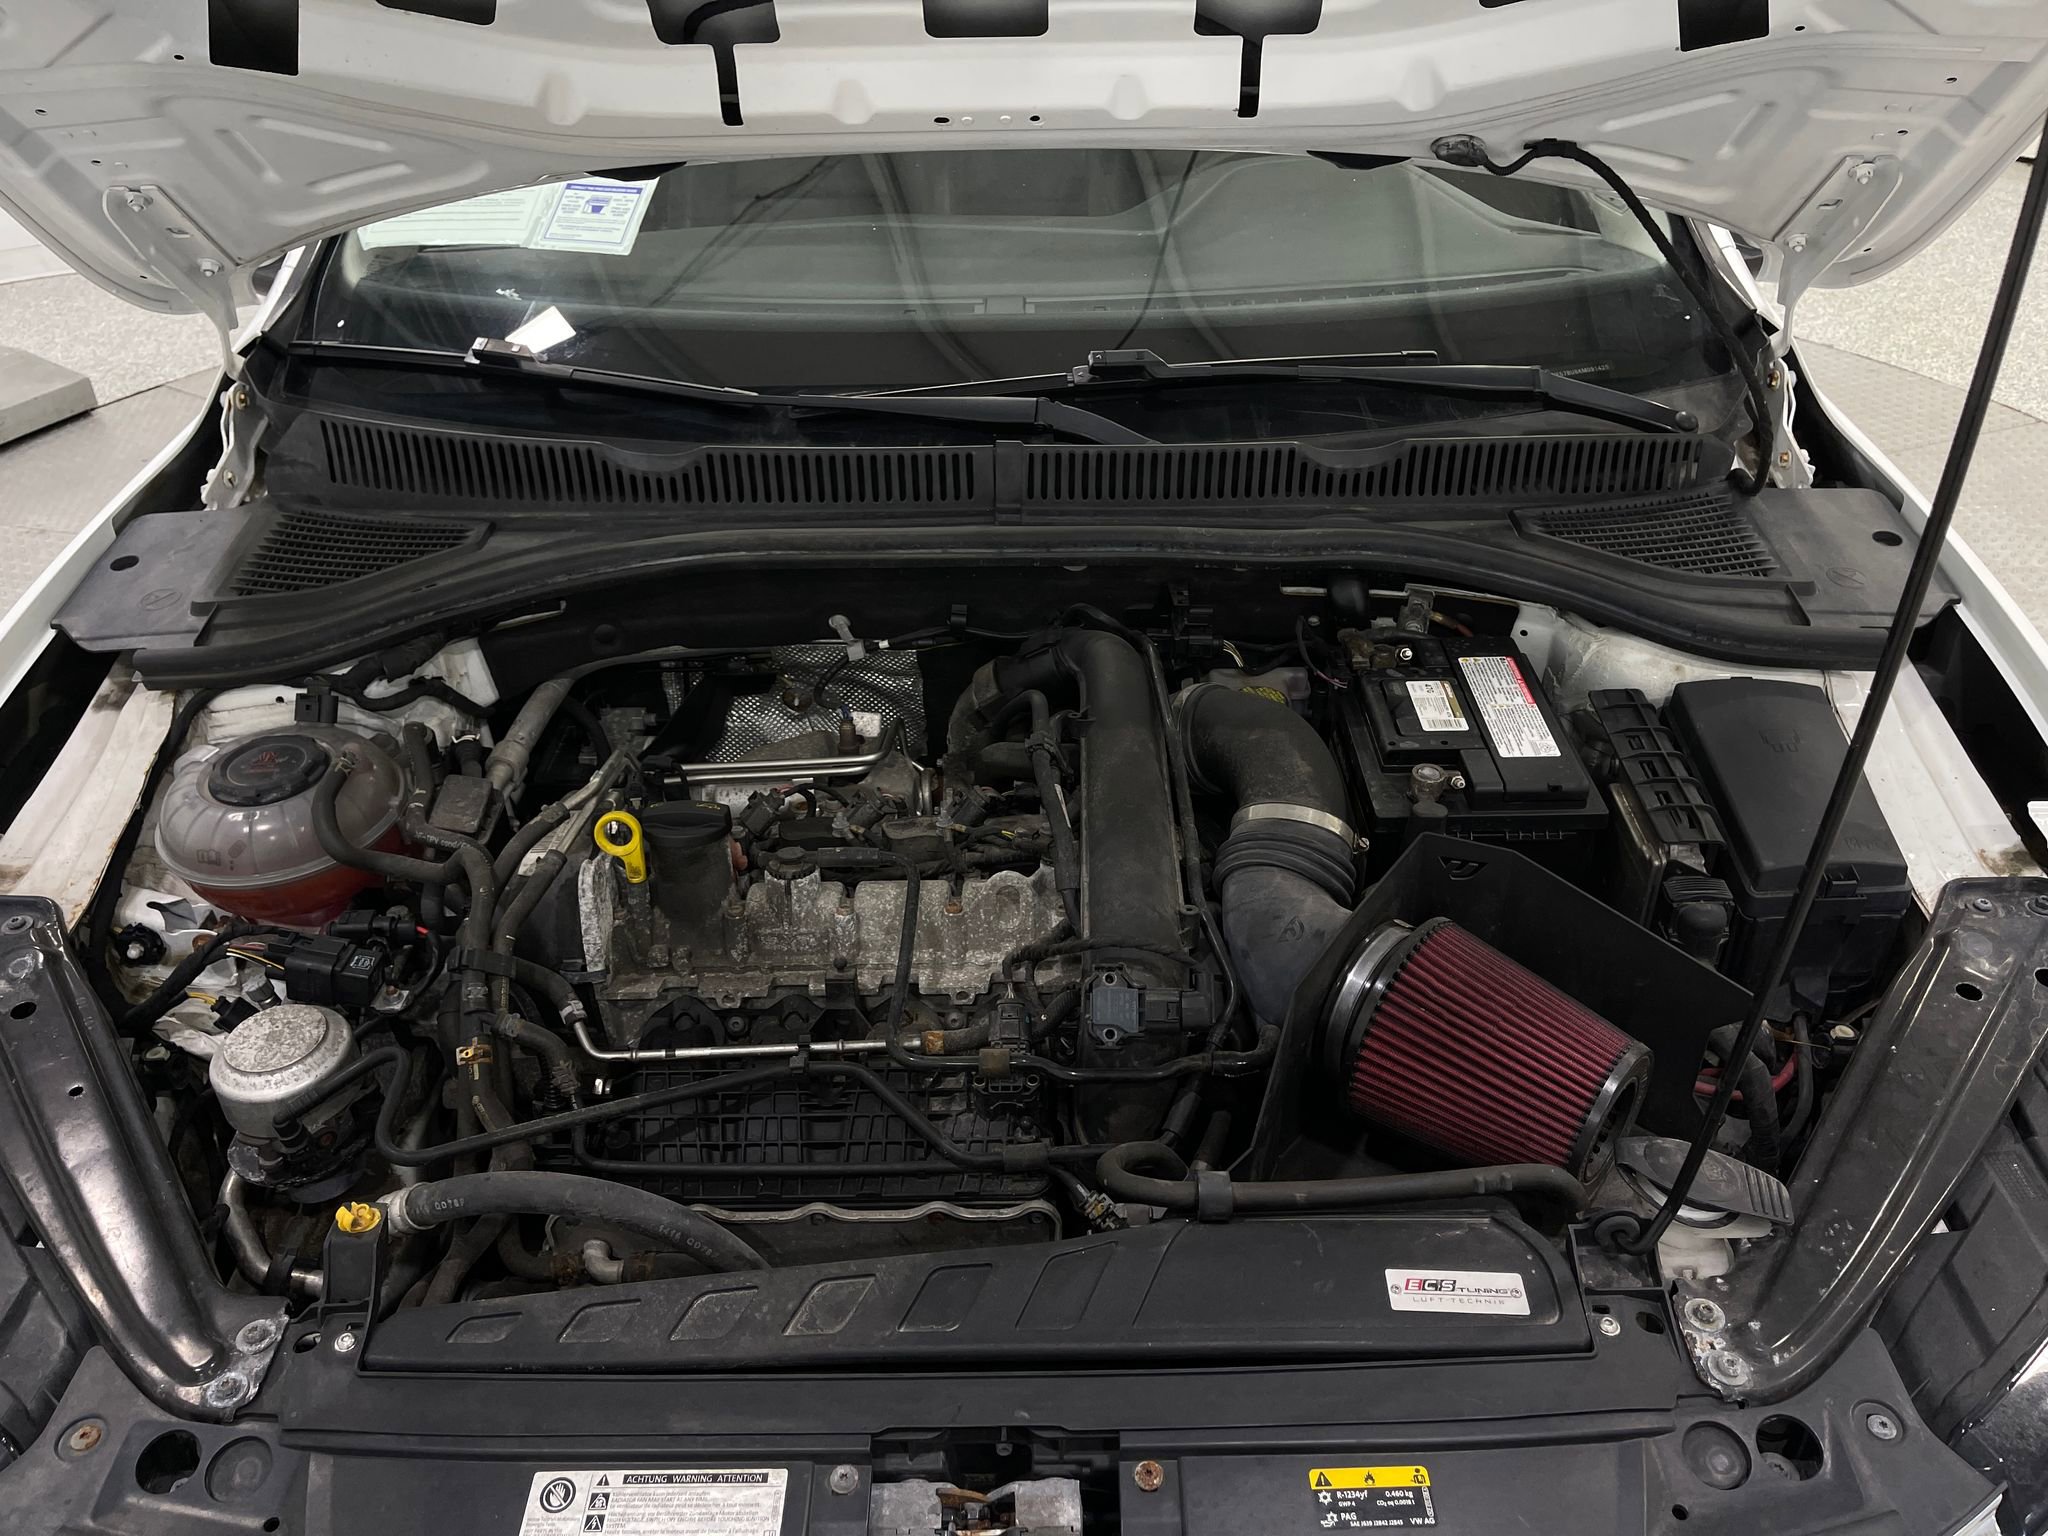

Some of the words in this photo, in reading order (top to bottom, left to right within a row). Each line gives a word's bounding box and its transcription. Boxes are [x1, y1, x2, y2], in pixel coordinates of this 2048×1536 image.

[1405, 1279, 1456, 1291] ECS
[626, 1475, 668, 1483] ACHTUNG
[672, 1475, 713, 1483] WARNING
[717, 1474, 763, 1482] ATTENTION
[1336, 1490, 1368, 1500] R-1234yf
[1385, 1490, 1404, 1498] 0.460
[1405, 1490, 1413, 1498] kg
[1340, 1512, 1357, 1520] PAG
